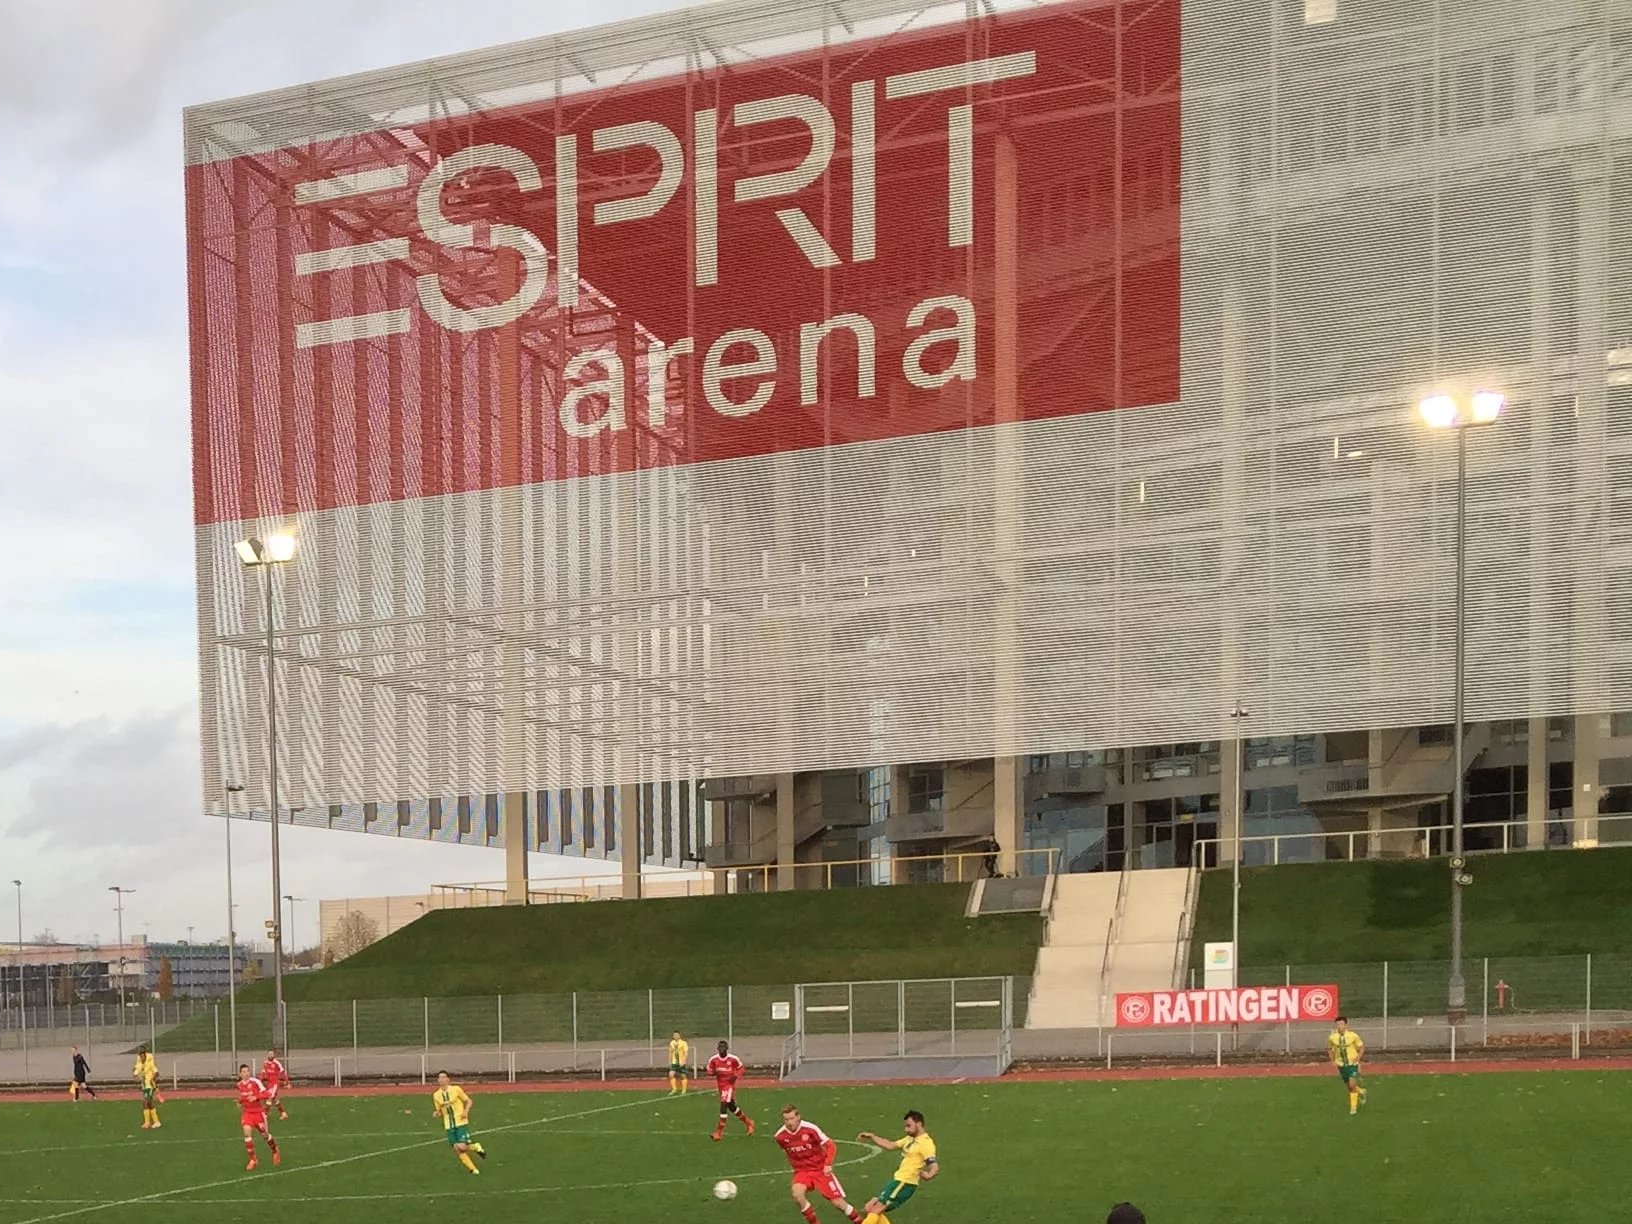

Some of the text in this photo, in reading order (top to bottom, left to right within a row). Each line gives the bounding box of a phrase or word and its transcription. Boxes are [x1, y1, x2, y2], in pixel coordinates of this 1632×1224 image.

[294, 50, 1037, 350] ESPRIT
[557, 293, 978, 437] arena
[1153, 987, 1300, 1024] RATINGEN
